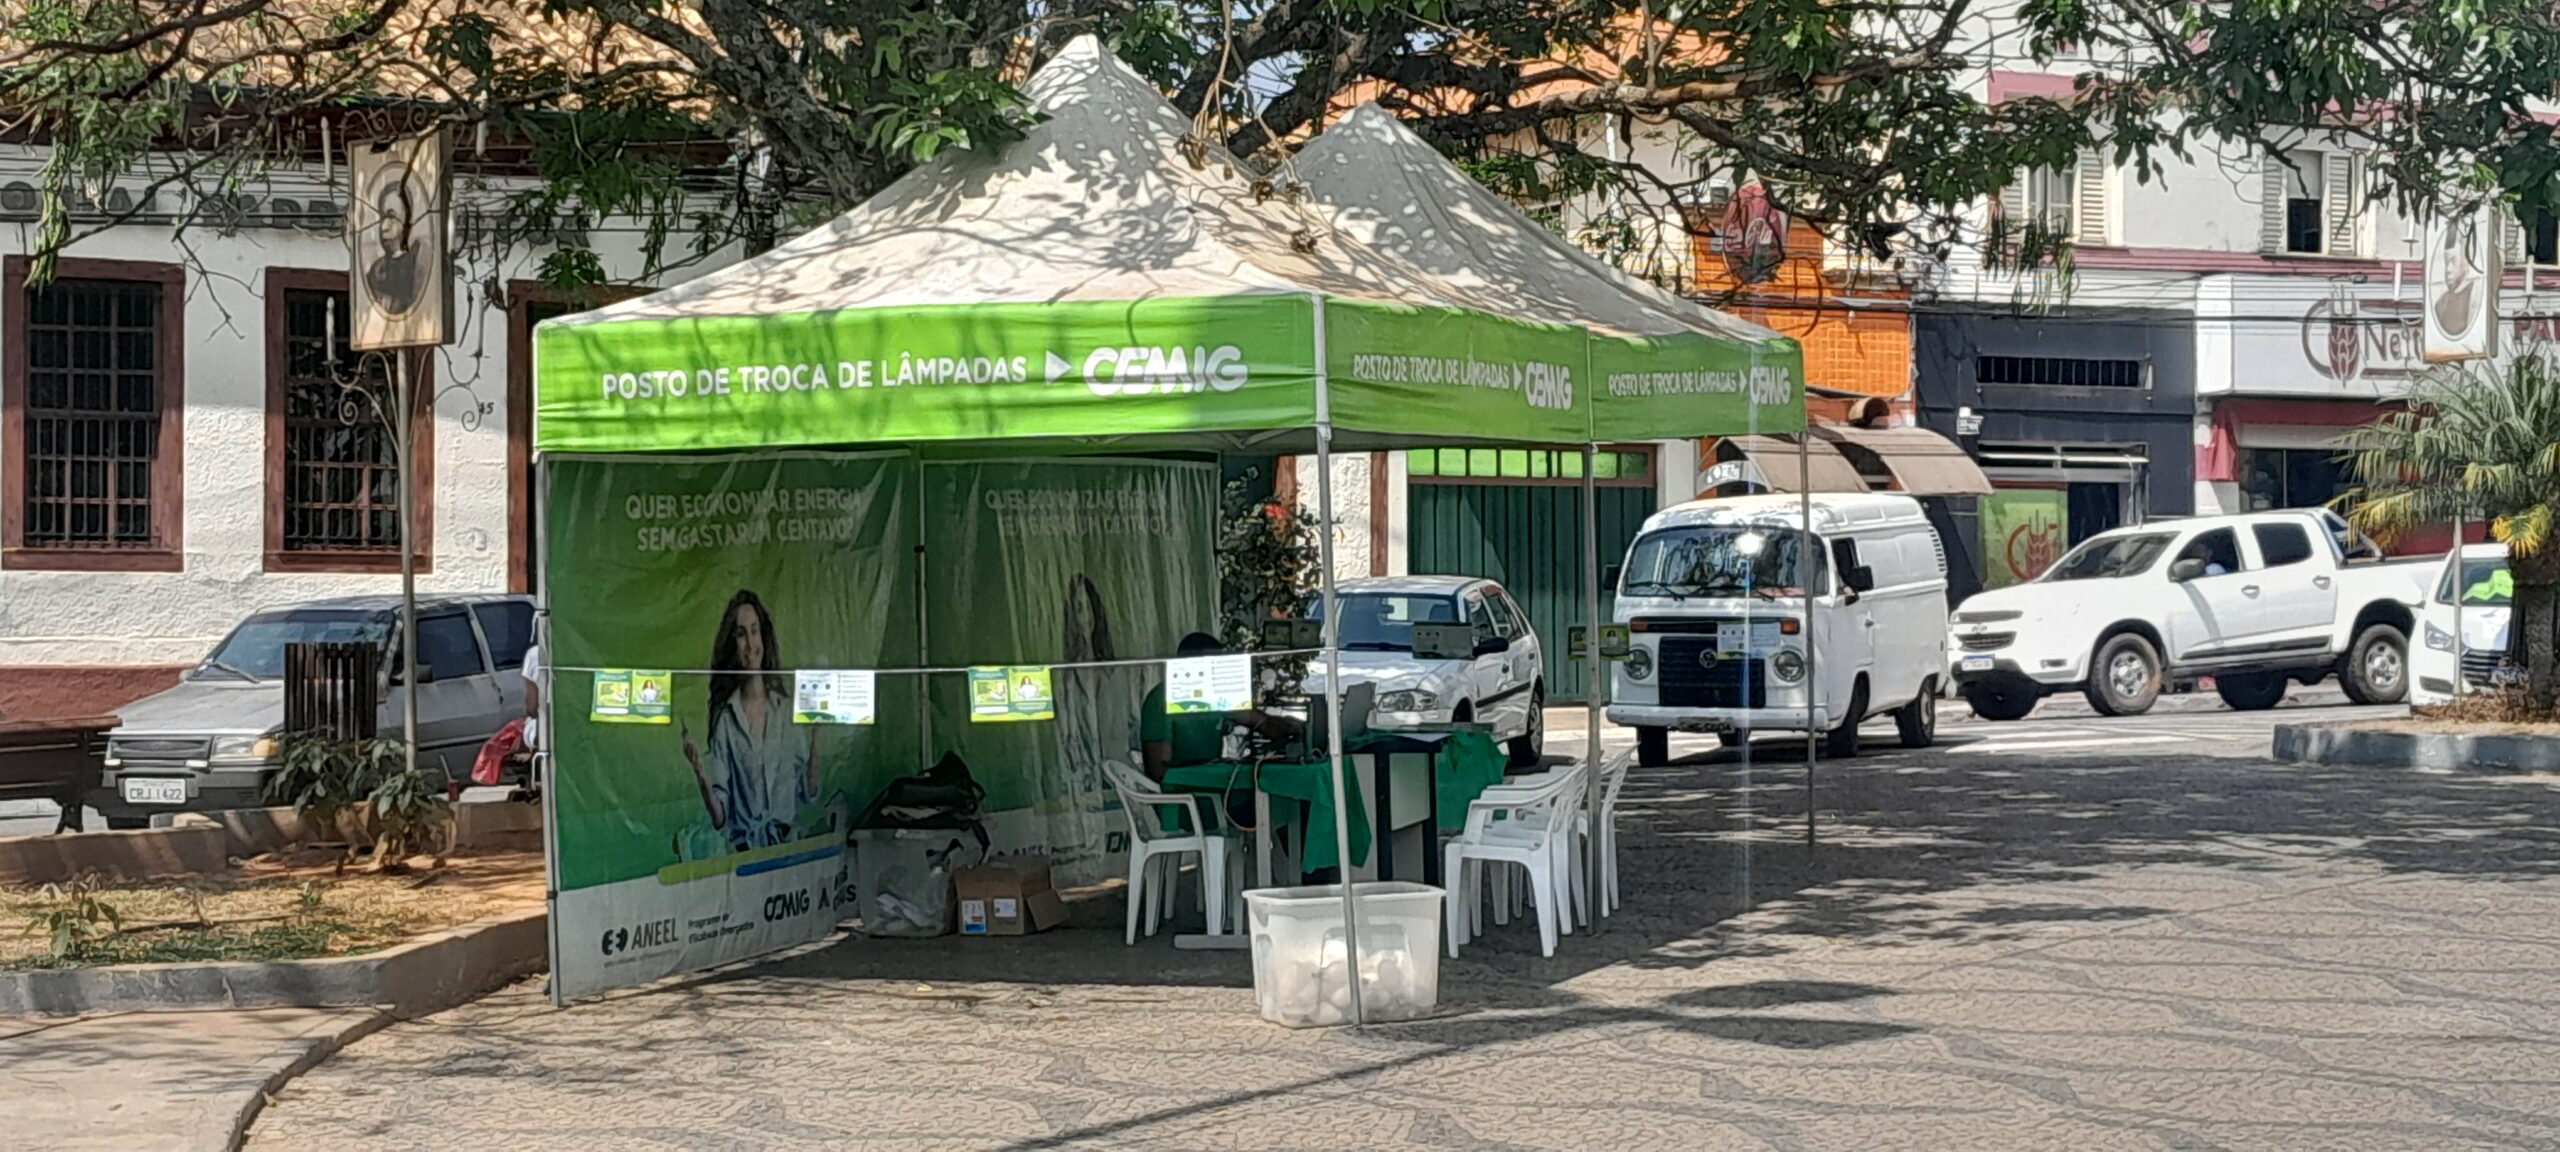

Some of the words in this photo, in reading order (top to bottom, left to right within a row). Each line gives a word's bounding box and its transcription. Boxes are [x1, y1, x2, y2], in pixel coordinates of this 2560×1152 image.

[602, 369, 688, 400] POSTO
[696, 367, 731, 396] DE
[738, 362, 829, 393] TROCA
[837, 360, 873, 389] DE
[880, 351, 1027, 387] LÂMPADAS
[1082, 345, 1249, 396] CEMIG
[1353, 354, 1391, 381] POSTO
[1392, 355, 1409, 382] DE
[1409, 356, 1444, 384] TROCA
[1445, 358, 1459, 386] DE
[1460, 354, 1510, 390] LÂMPADAS
[1525, 361, 1573, 410] CEMIG
[1608, 373, 1638, 397] POSTO
[1639, 372, 1651, 396] DE
[1652, 372, 1681, 394] TROCA
[1681, 371, 1694, 393] DE
[1749, 366, 1792, 405] CEMIG
[625, 493, 679, 519] QUER
[637, 525, 676, 551] SEM
[764, 888, 811, 922] CEMIG
[631, 917, 680, 951] ANEEL
